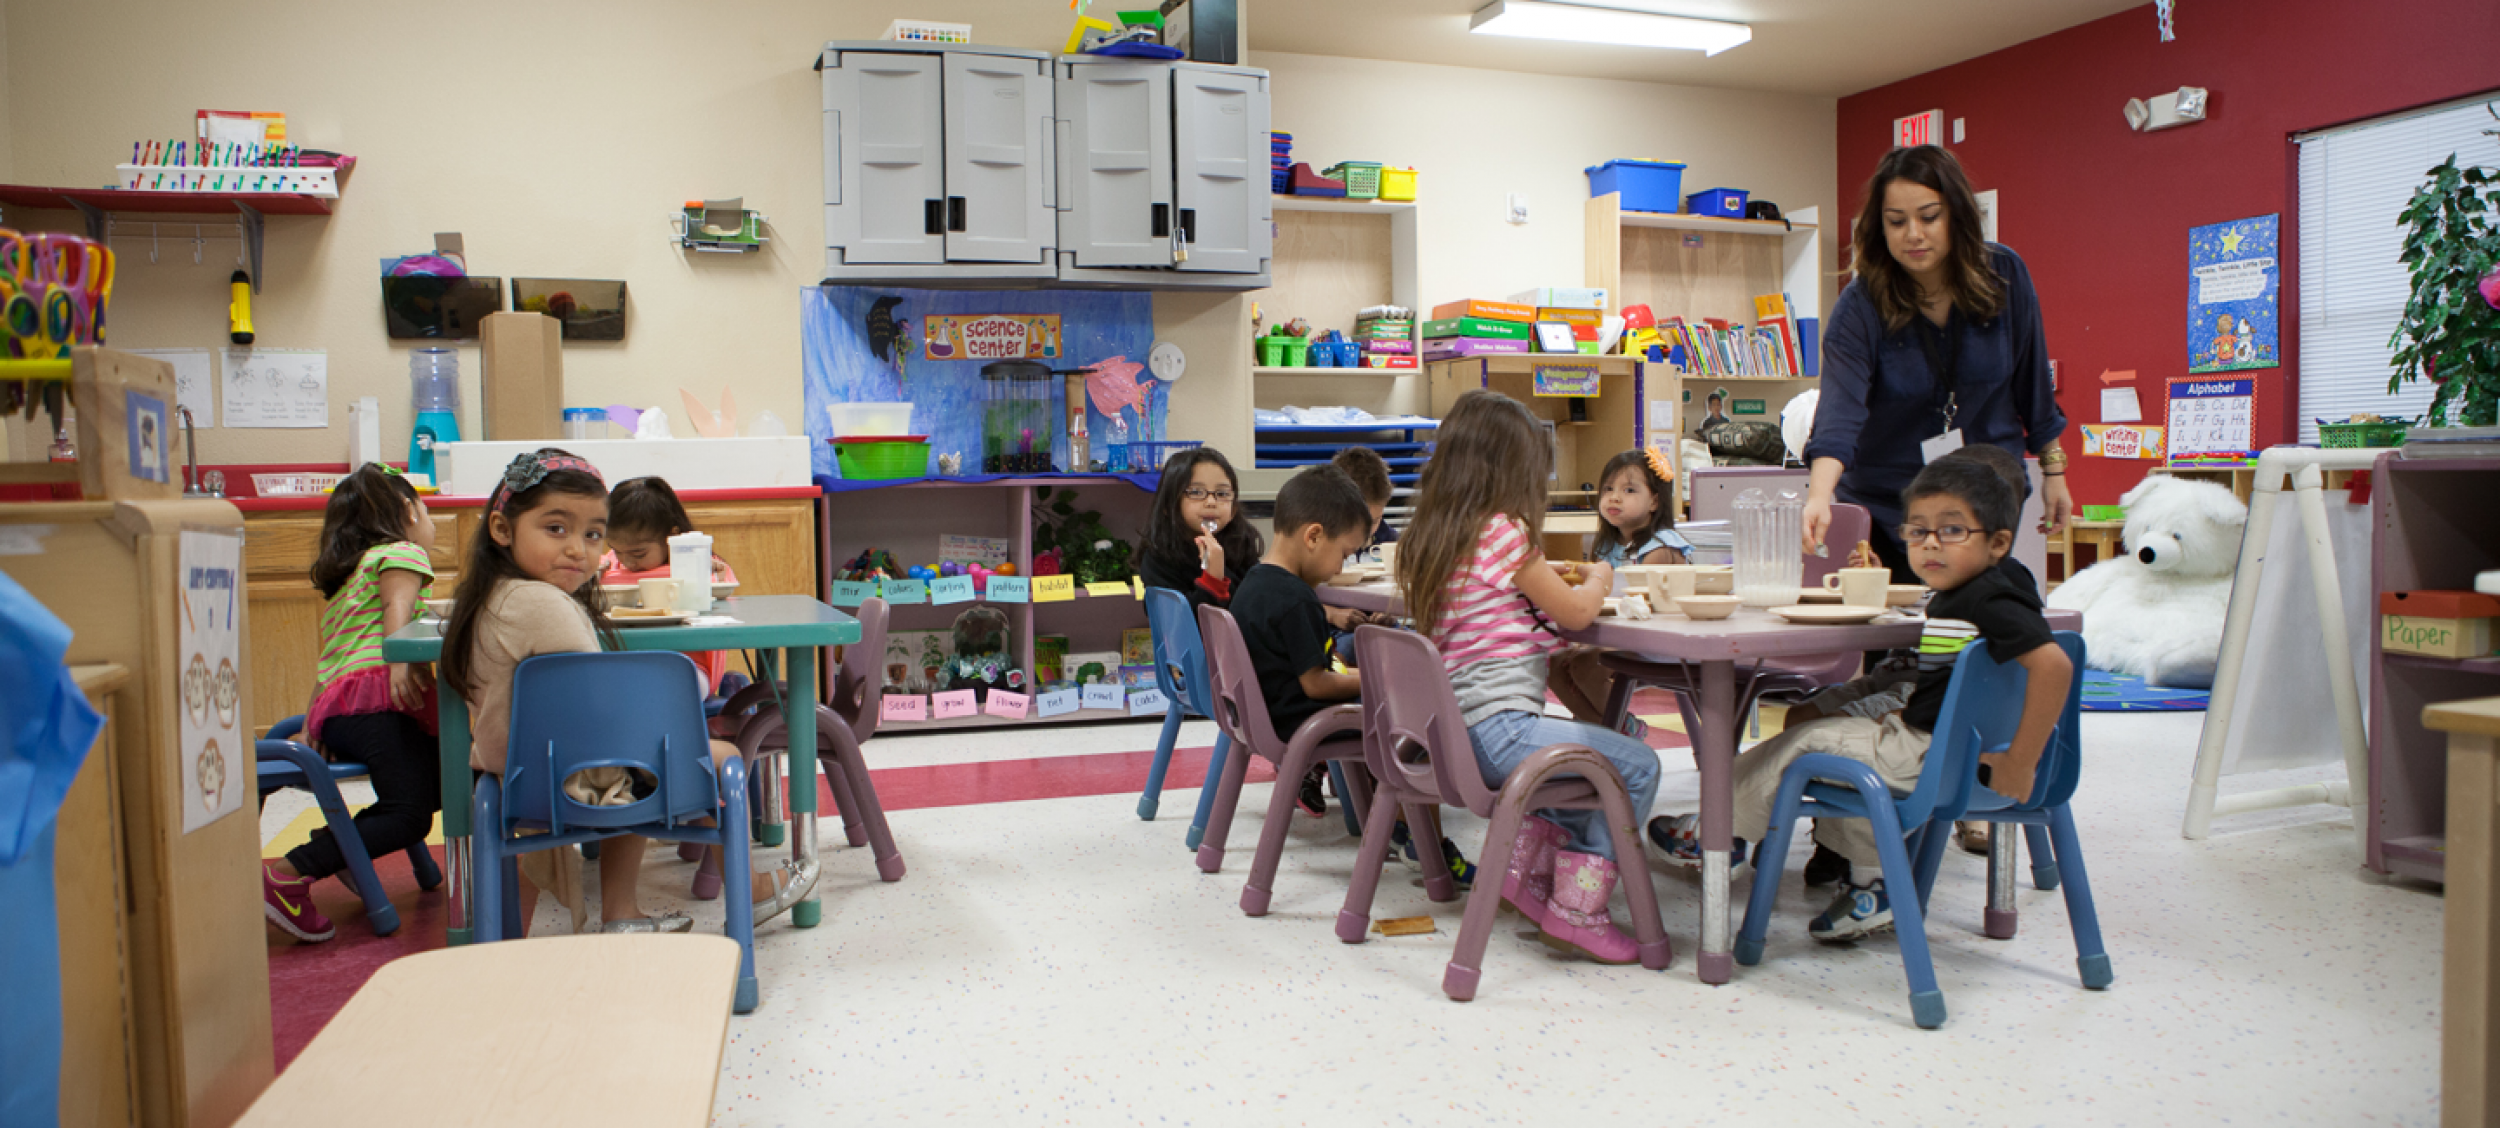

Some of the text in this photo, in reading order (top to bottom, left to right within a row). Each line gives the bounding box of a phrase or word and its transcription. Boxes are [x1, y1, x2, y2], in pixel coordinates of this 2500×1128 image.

[1901, 113, 1931, 148] EXIT
[966, 320, 1025, 337] science
[968, 339, 1022, 357] center
[2187, 381, 2236, 396] Alphabet
[2172, 398, 2248, 411] Aa Bb Cc Dd
[2174, 414, 2187, 427] Ee
[2193, 414, 2208, 426] Ff
[2230, 414, 2246, 426] Hh
[2105, 429, 2140, 443] writing
[2208, 428, 2225, 441] Kk
[2105, 442, 2137, 457] center
[888, 583, 914, 595] colors
[935, 582, 966, 594] sorting
[992, 580, 1025, 597] pattern
[1039, 578, 1069, 591] habitat
[841, 587, 860, 596] mix
[2388, 614, 2452, 650] Paper
[888, 699, 916, 711] seed
[940, 698, 965, 711] grow
[995, 696, 1023, 709] flower
[1134, 694, 1159, 707] catch
